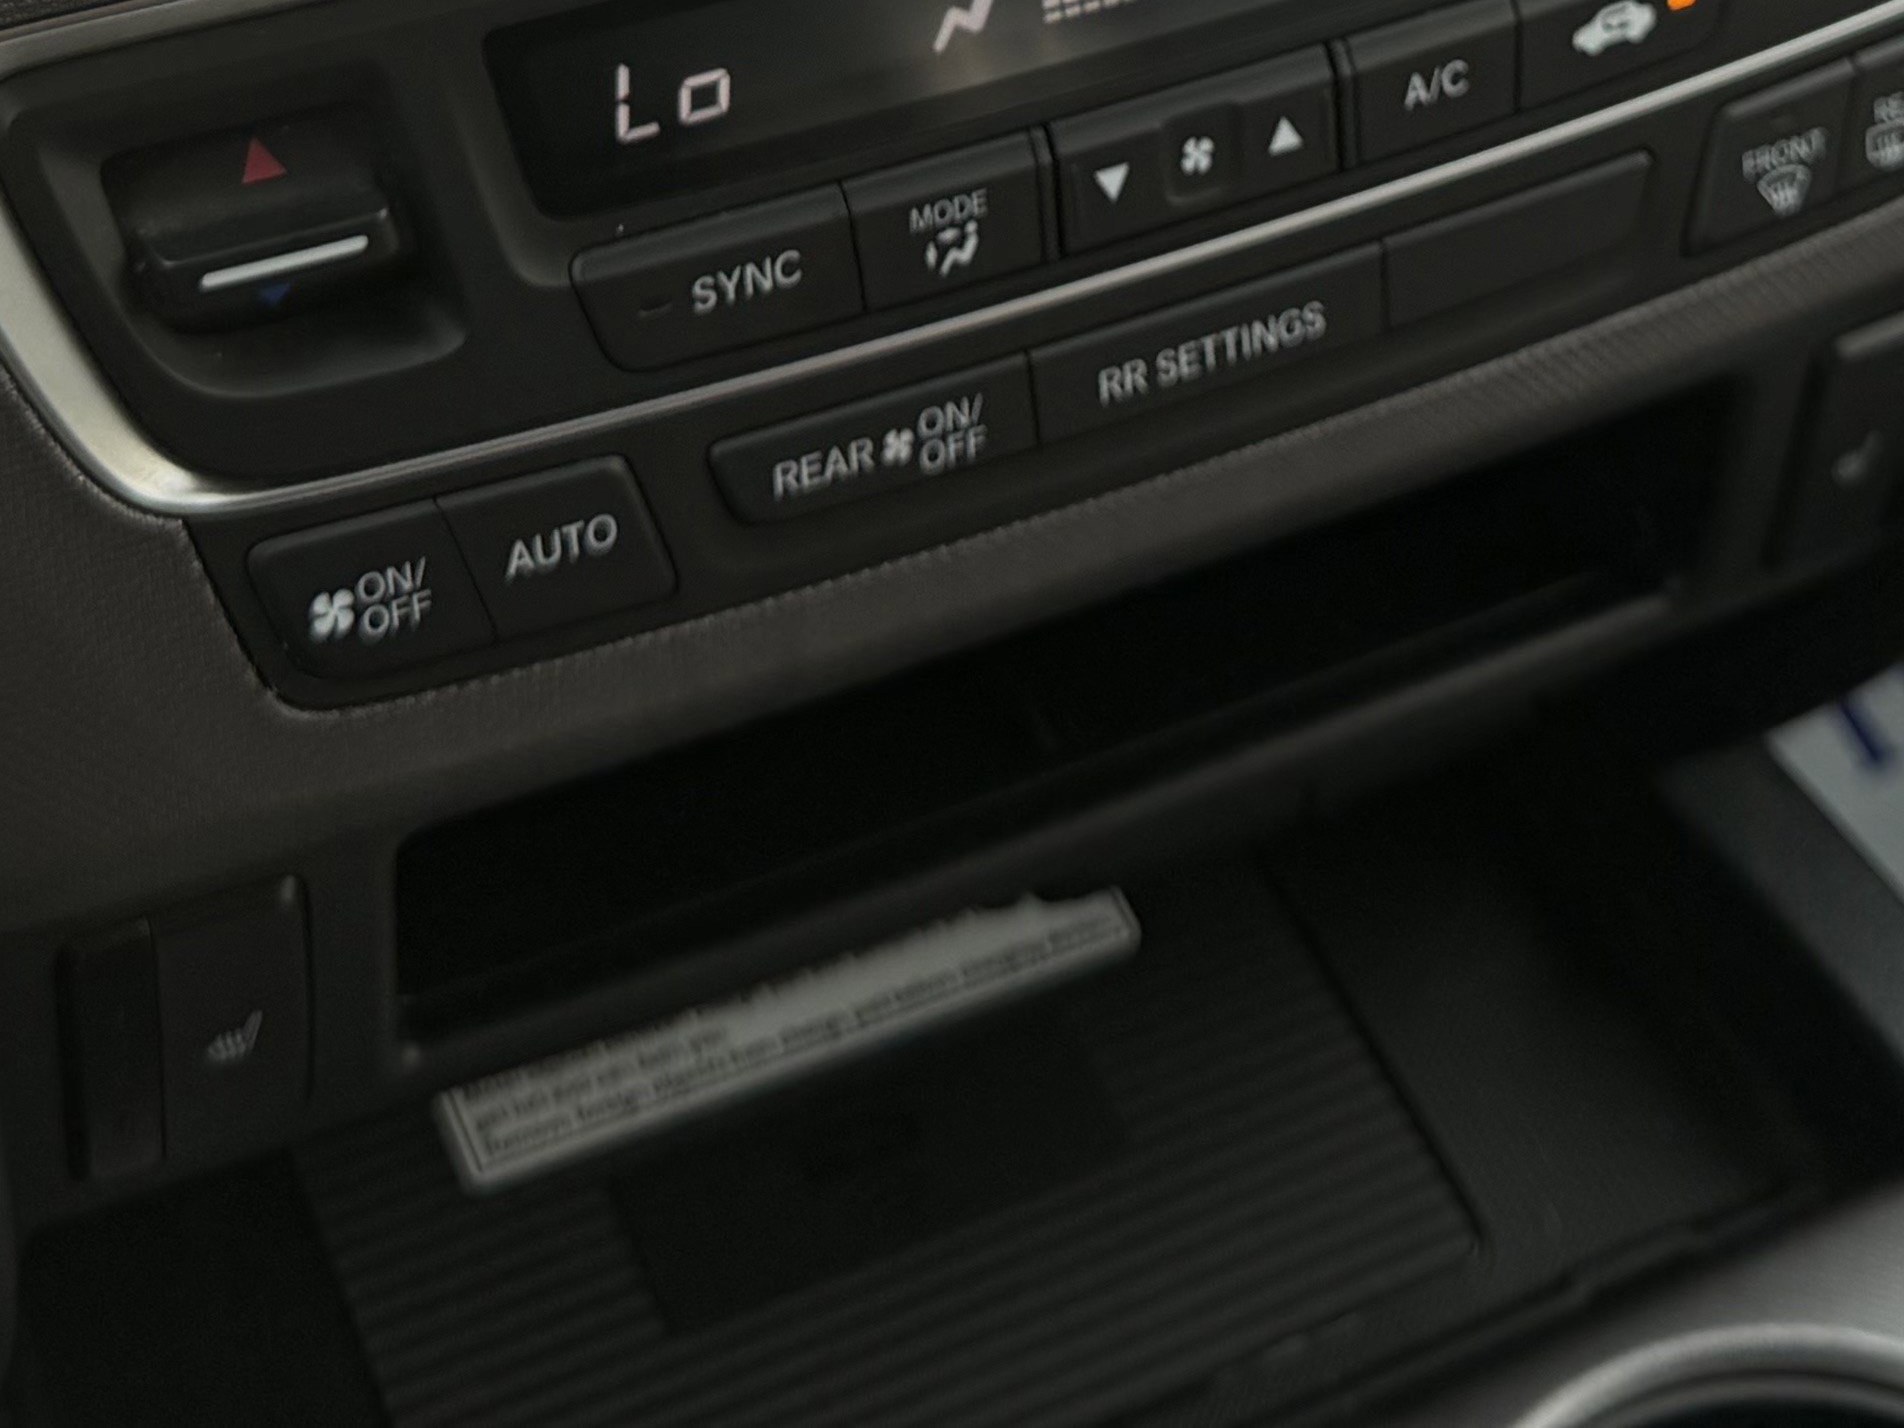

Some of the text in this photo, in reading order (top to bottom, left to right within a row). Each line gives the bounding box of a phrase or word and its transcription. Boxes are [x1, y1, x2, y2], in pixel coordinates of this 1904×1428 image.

[615, 62, 732, 144] Lo
[1403, 58, 1470, 112] A/C
[909, 188, 990, 234] MODE
[691, 248, 804, 318] SYNC
[1097, 299, 1327, 404] RR SETTINGS
[771, 447, 875, 501] REAR
[917, 424, 989, 478] OFF
[503, 510, 620, 581] AUTO
[357, 589, 433, 642] OFF
